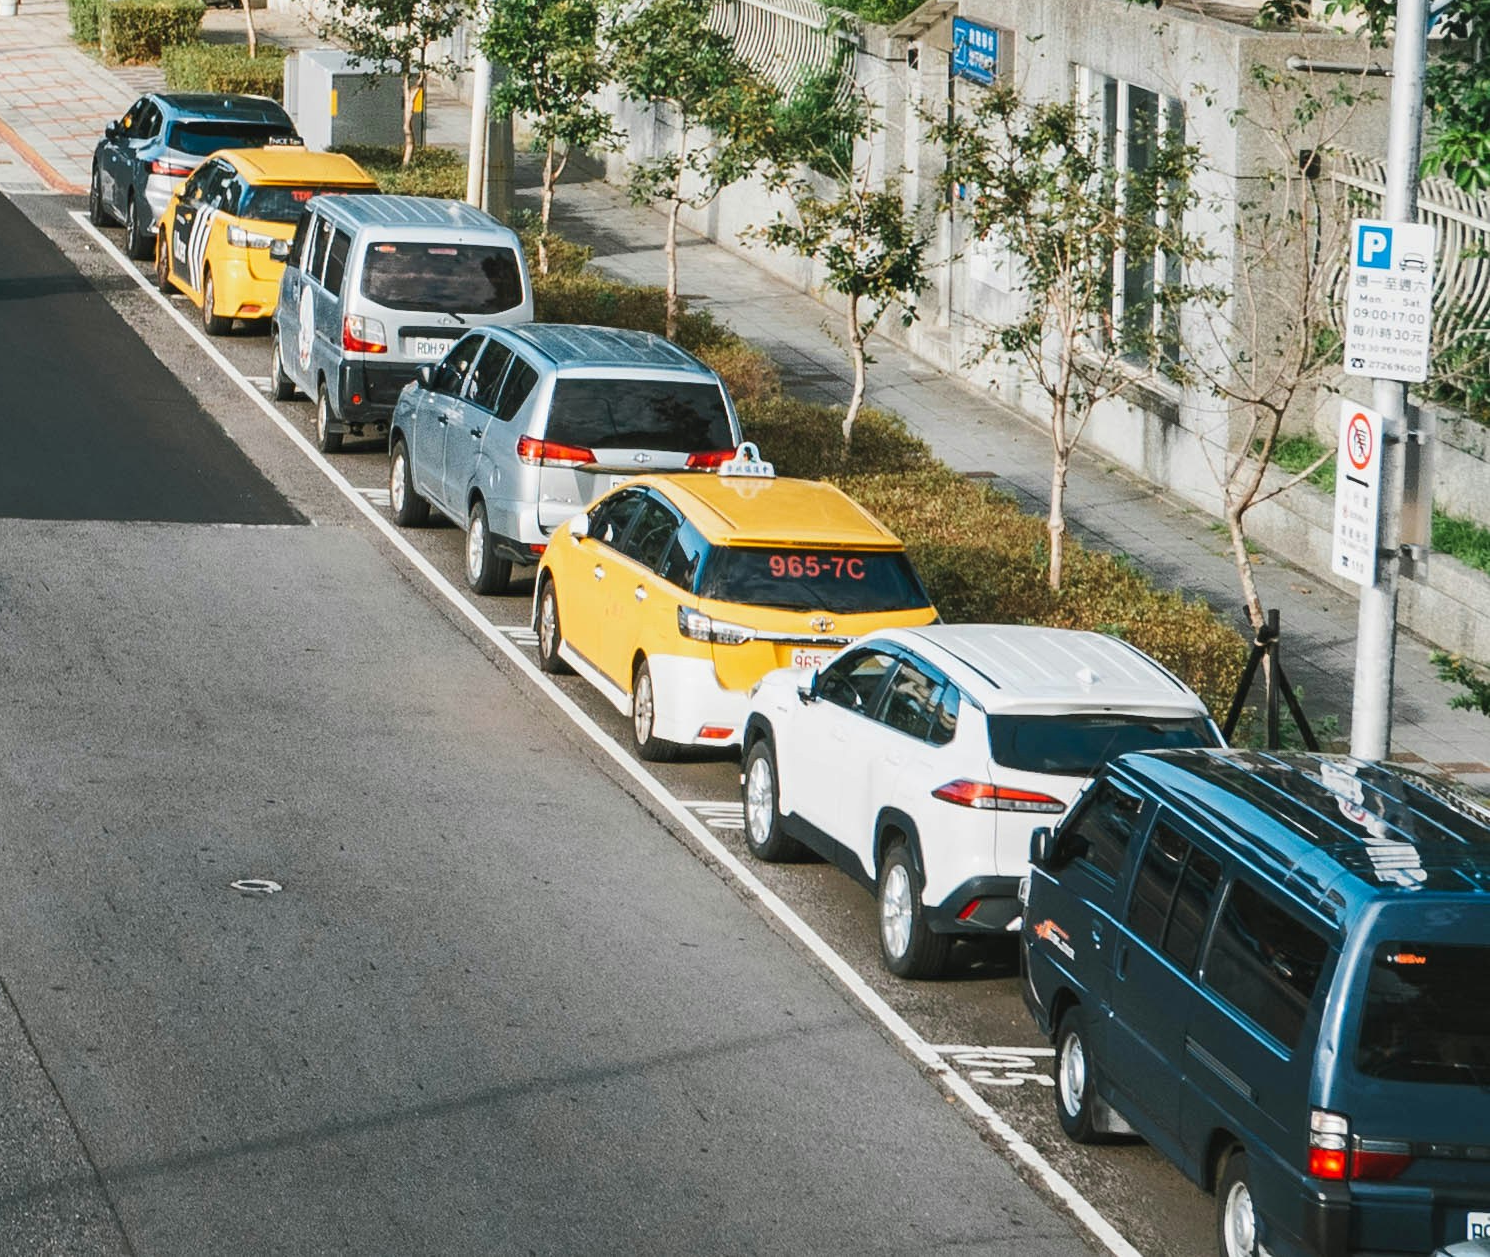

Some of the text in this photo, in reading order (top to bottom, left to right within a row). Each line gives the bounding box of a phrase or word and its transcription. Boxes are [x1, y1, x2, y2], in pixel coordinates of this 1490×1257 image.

[1362, 231, 1387, 263] P
[1356, 274, 1427, 293] 週一至週六
[1353, 307, 1425, 324] 09:00-17:00
[769, 555, 865, 579] 965-7C
